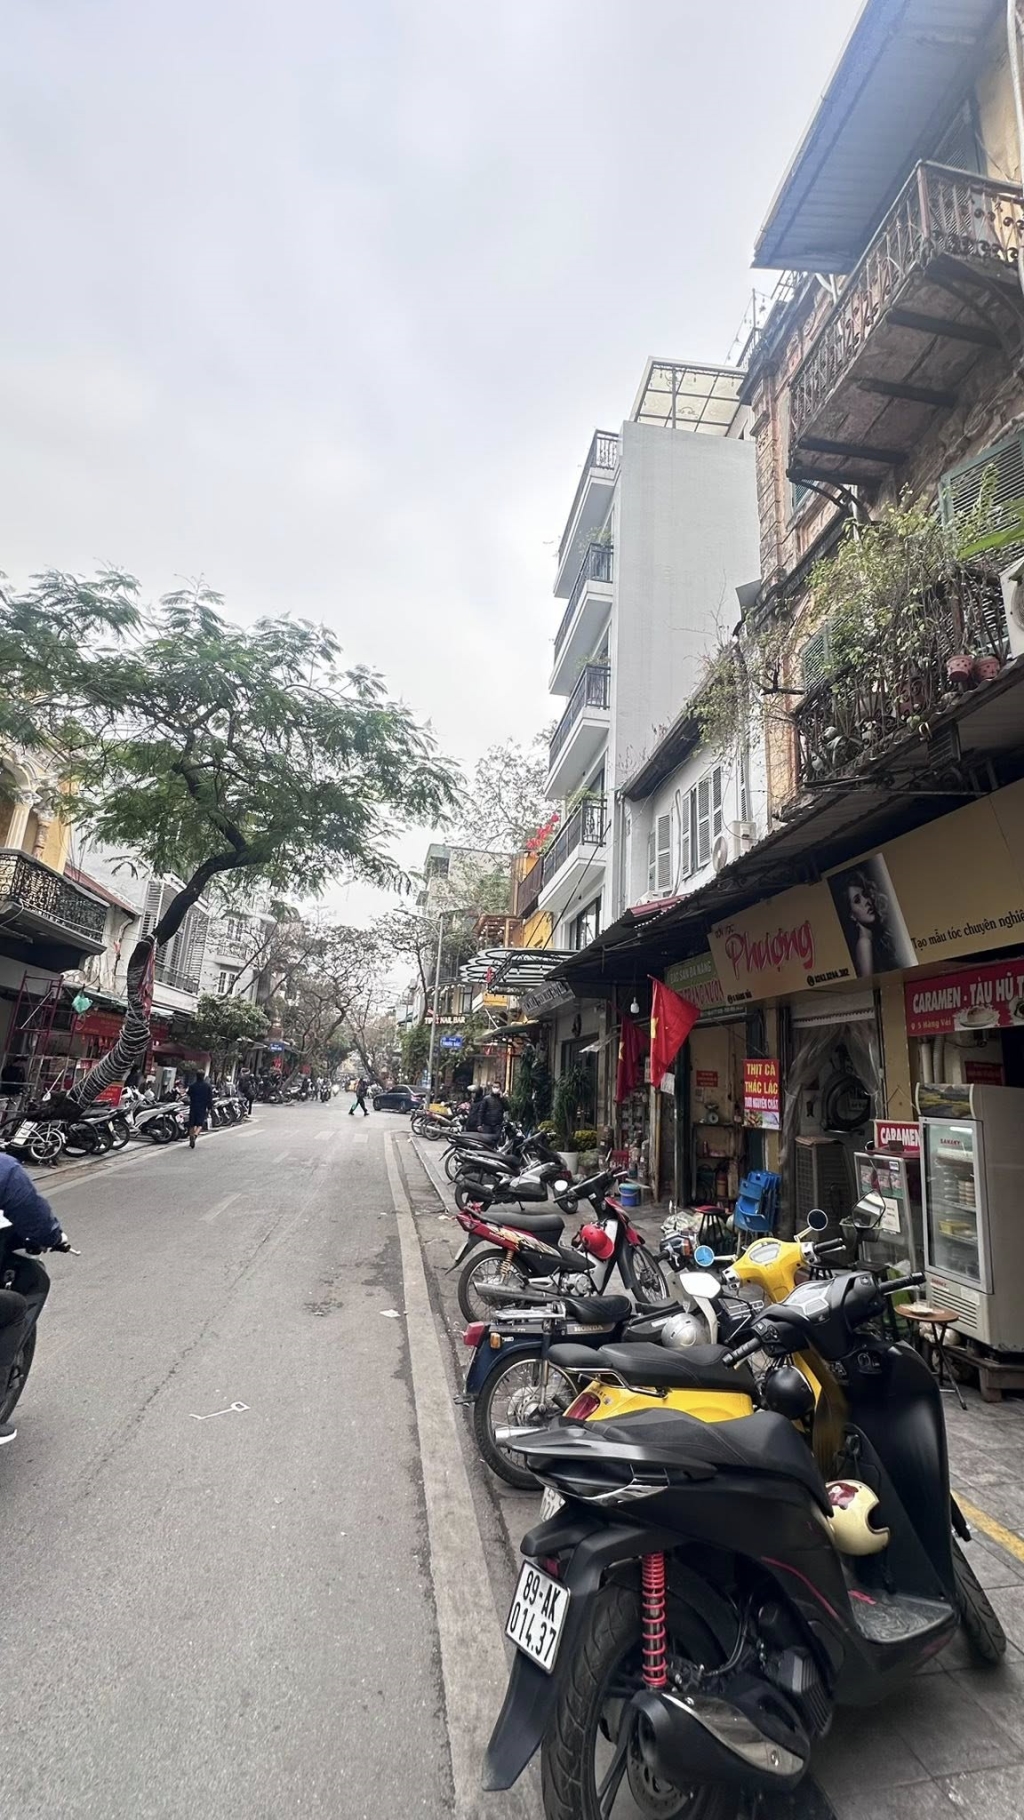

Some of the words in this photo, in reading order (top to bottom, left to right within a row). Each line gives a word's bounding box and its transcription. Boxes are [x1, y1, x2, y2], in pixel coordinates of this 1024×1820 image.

[725, 920, 815, 981] Phượng
[910, 937, 927, 951] Tạo
[928, 928, 947, 945] mẫu
[947, 926, 962, 940] tóc
[963, 918, 997, 935] chuyên
[913, 986, 961, 1014] CARAMEN
[969, 977, 993, 1005] TÀU
[745, 1079, 762, 1094] THÁC
[763, 1079, 779, 1095] LÁC
[747, 1063, 763, 1078] THỊT
[880, 1127, 921, 1147] CARAMEN
[573, 1324, 604, 1332] HONDA
[522, 1570, 562, 1623] 89-AK
[509, 1601, 557, 1663] 014.37
